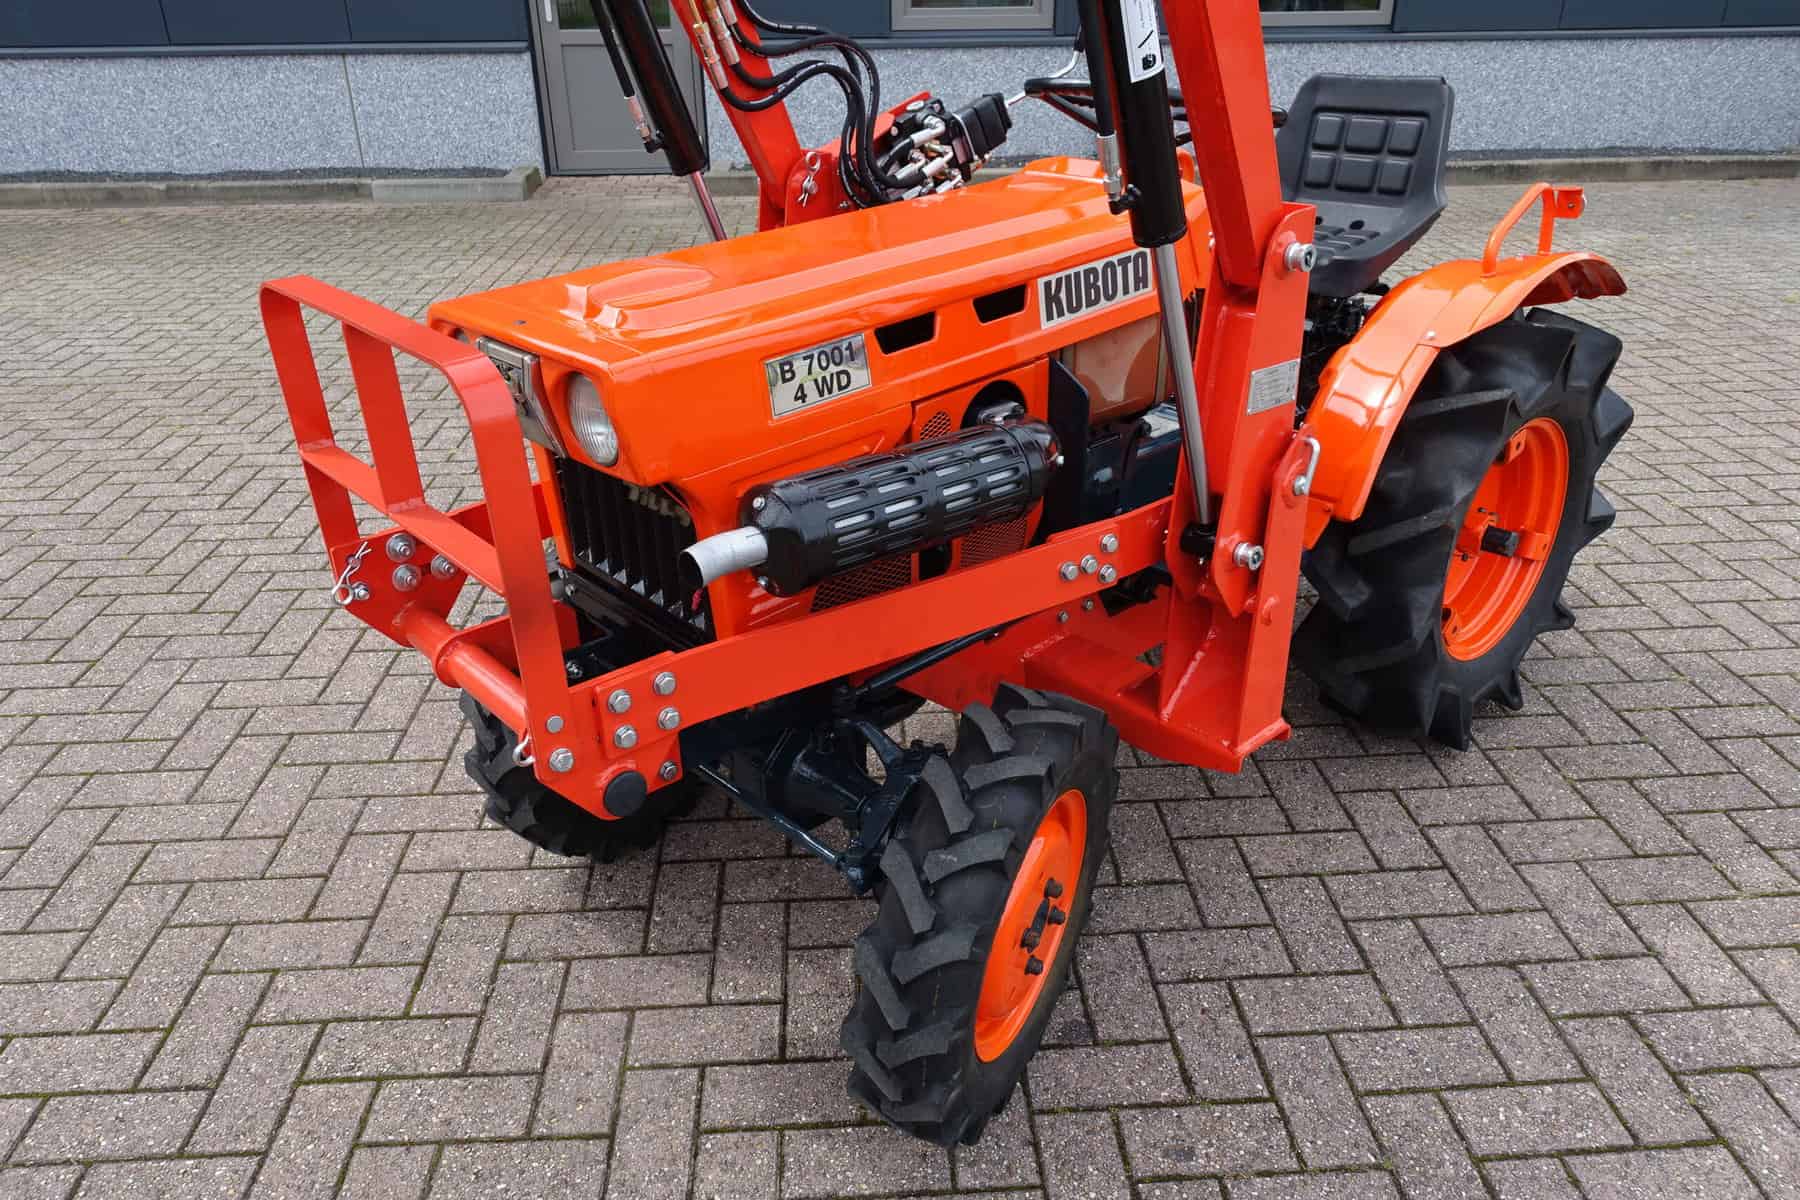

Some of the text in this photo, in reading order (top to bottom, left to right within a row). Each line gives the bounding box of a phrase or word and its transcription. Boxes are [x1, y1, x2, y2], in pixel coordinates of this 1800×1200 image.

[1043, 250, 1149, 322] KUBOTA
[778, 341, 856, 384] B 7001
[793, 369, 852, 403] 4 WD
